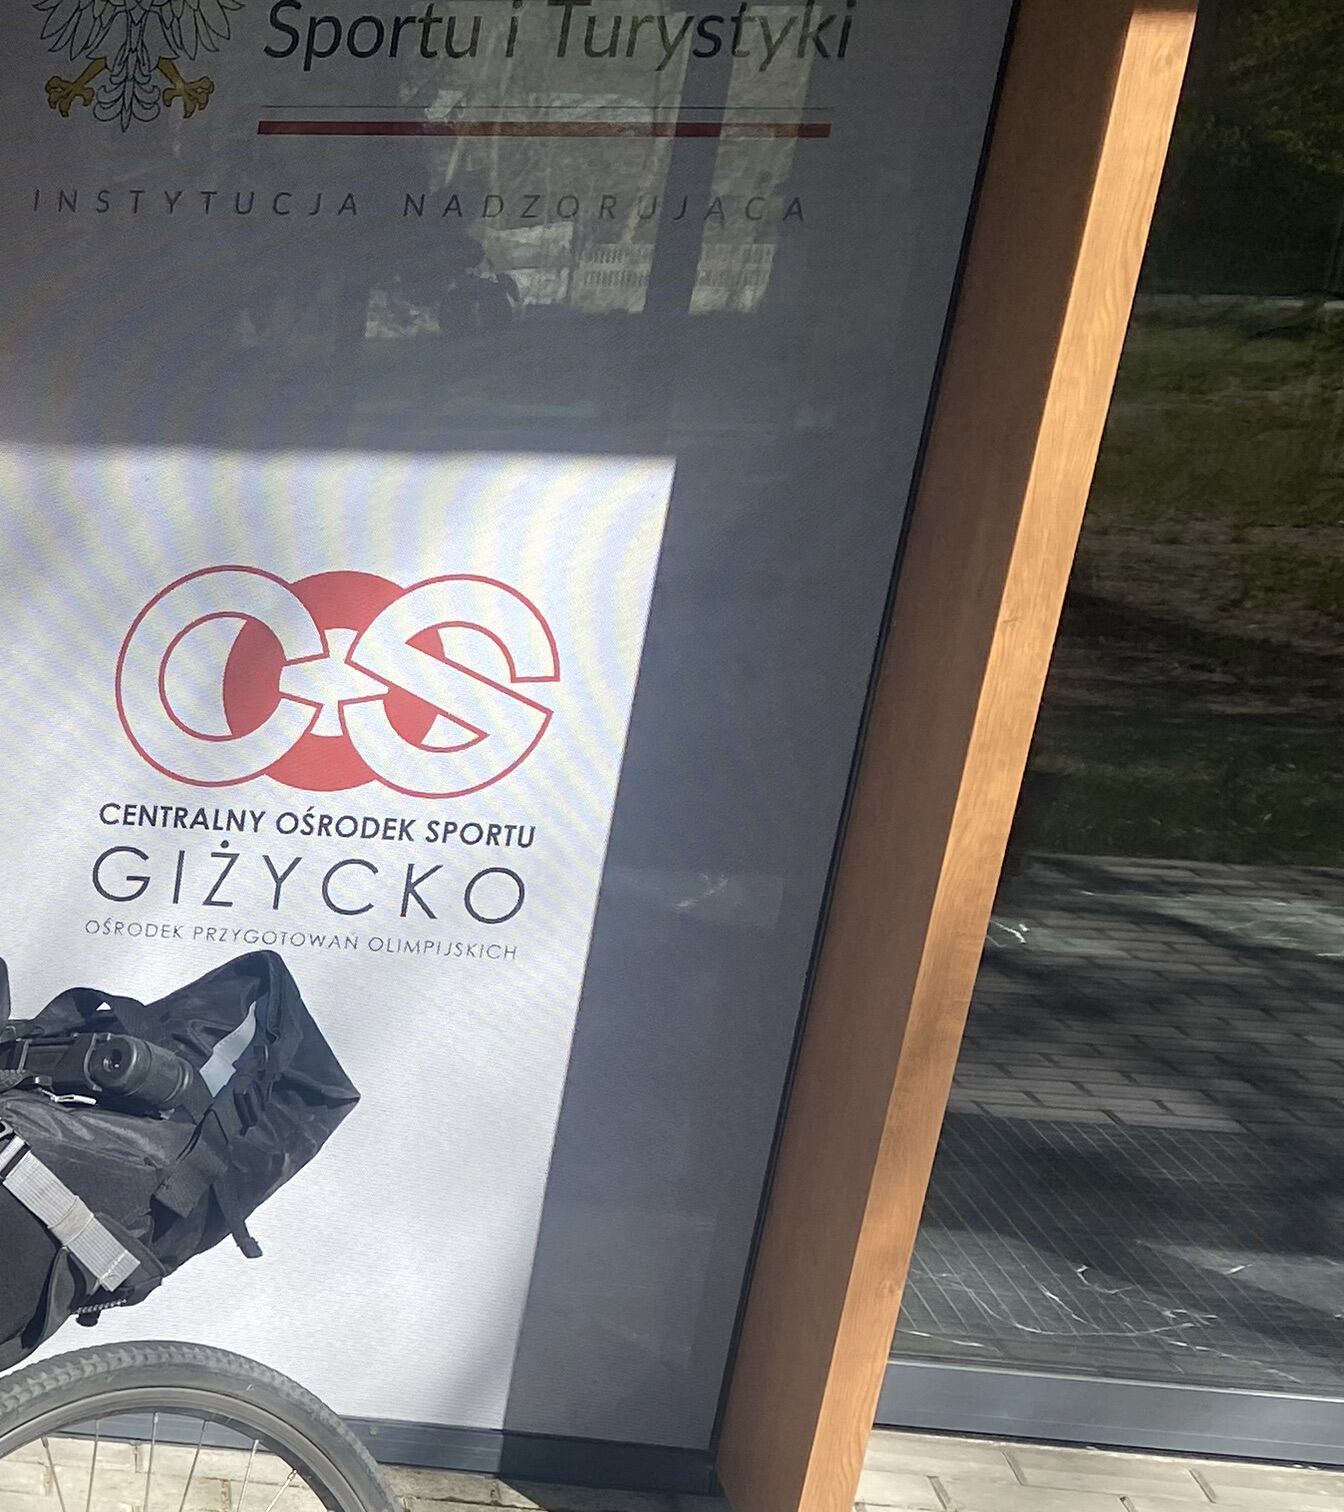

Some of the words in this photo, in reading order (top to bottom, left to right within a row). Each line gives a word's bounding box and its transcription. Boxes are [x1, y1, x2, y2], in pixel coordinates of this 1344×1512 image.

[263, 0, 482, 72] Sportu
[504, 2, 521, 58] i
[548, 0, 858, 72] Turystyki
[32, 189, 359, 216] INSTYTUCJA
[403, 193, 806, 226] NADZORUJĄCA
[98, 802, 267, 833] CENTRALNY
[275, 805, 416, 842] OŚRODEK
[425, 819, 537, 849] SPORTU
[92, 839, 526, 925] GIŻYCKO
[85, 917, 185, 939] OŚRODEK
[192, 925, 360, 951] PRZYGOTOWAŃ
[367, 935, 519, 961] OLIMPIJSKICH
